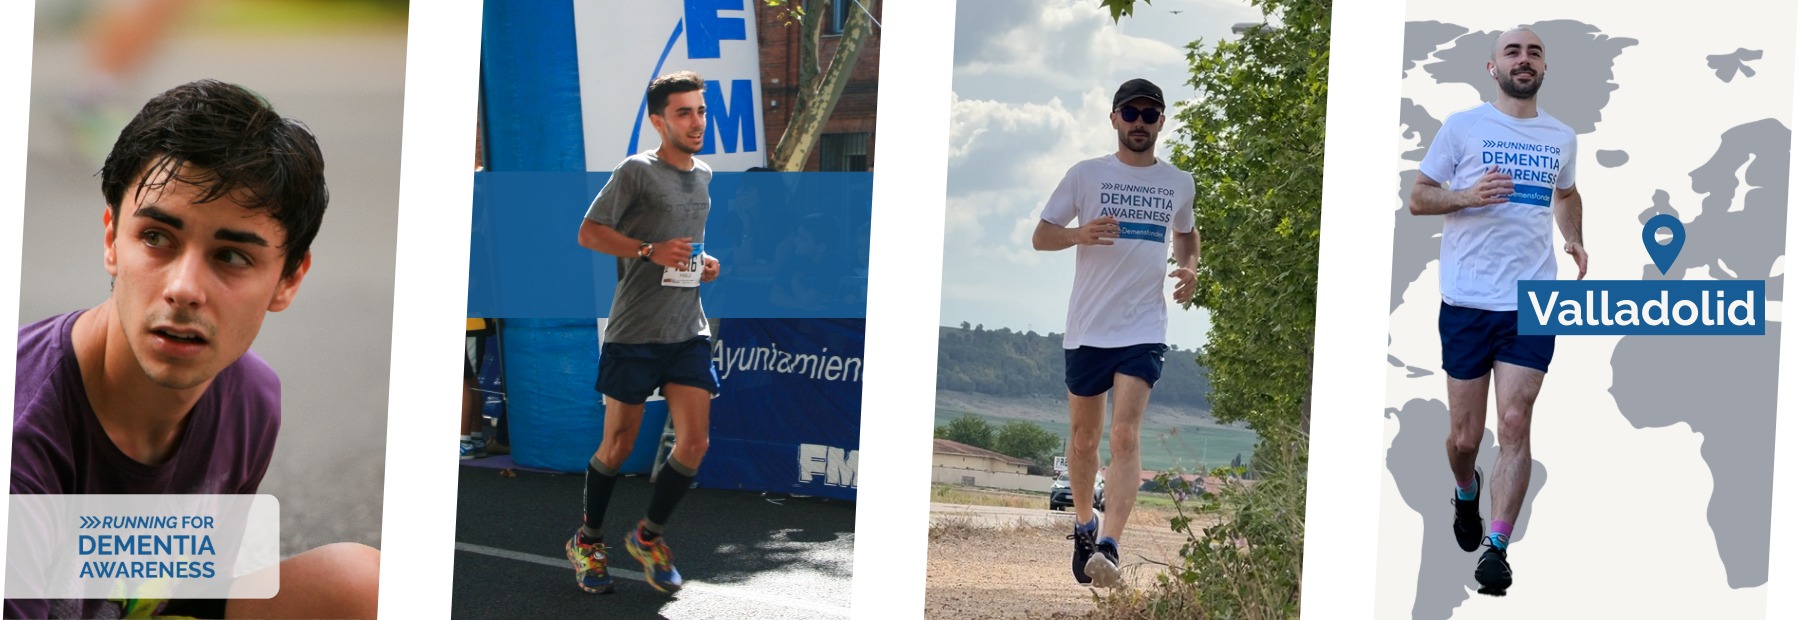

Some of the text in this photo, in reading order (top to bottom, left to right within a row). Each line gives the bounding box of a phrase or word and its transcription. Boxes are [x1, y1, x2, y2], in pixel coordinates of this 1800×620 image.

[1496, 140, 1561, 156] RUNNING FOR
[1482, 151, 1560, 171] DEMENTIA
[1484, 167, 1557, 185] ARENESS
[1113, 183, 1175, 198] RUNNING FOR
[1100, 192, 1173, 211] DEMENTIA
[1100, 207, 1171, 223] AWARENESS
